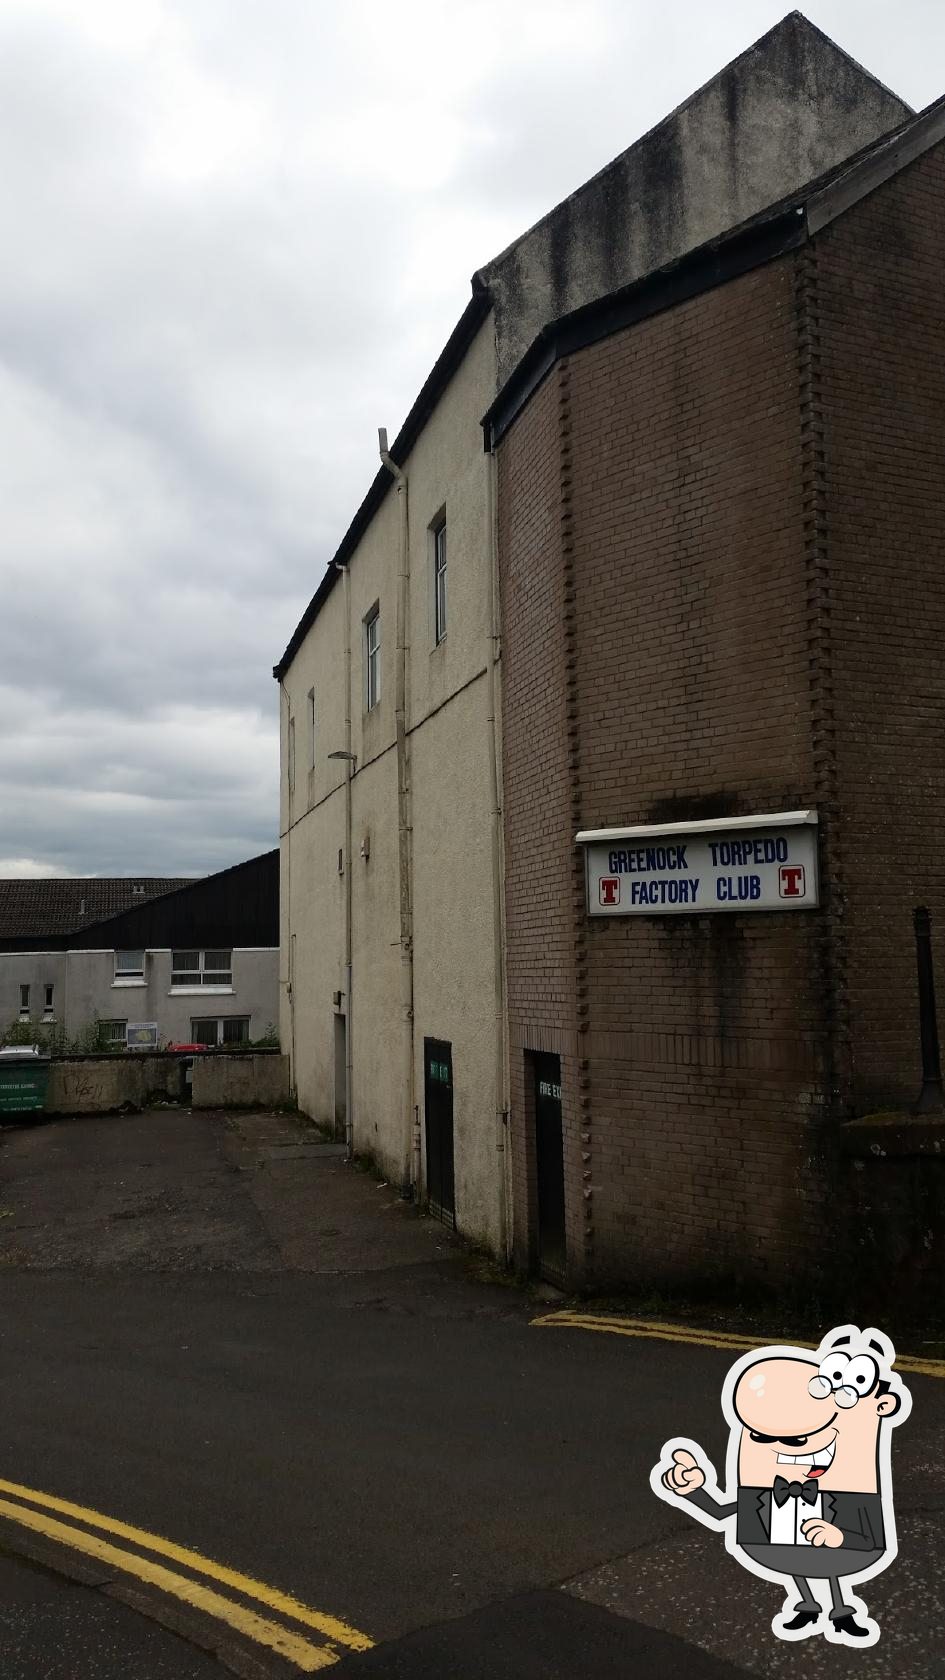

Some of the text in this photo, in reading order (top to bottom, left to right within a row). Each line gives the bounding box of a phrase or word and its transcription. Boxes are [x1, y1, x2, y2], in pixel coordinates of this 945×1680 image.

[608, 837, 788, 874] GREENOCK TORPEDO
[602, 880, 618, 903] T
[631, 875, 761, 905] FACTORY CLUB
[781, 868, 802, 895] T
